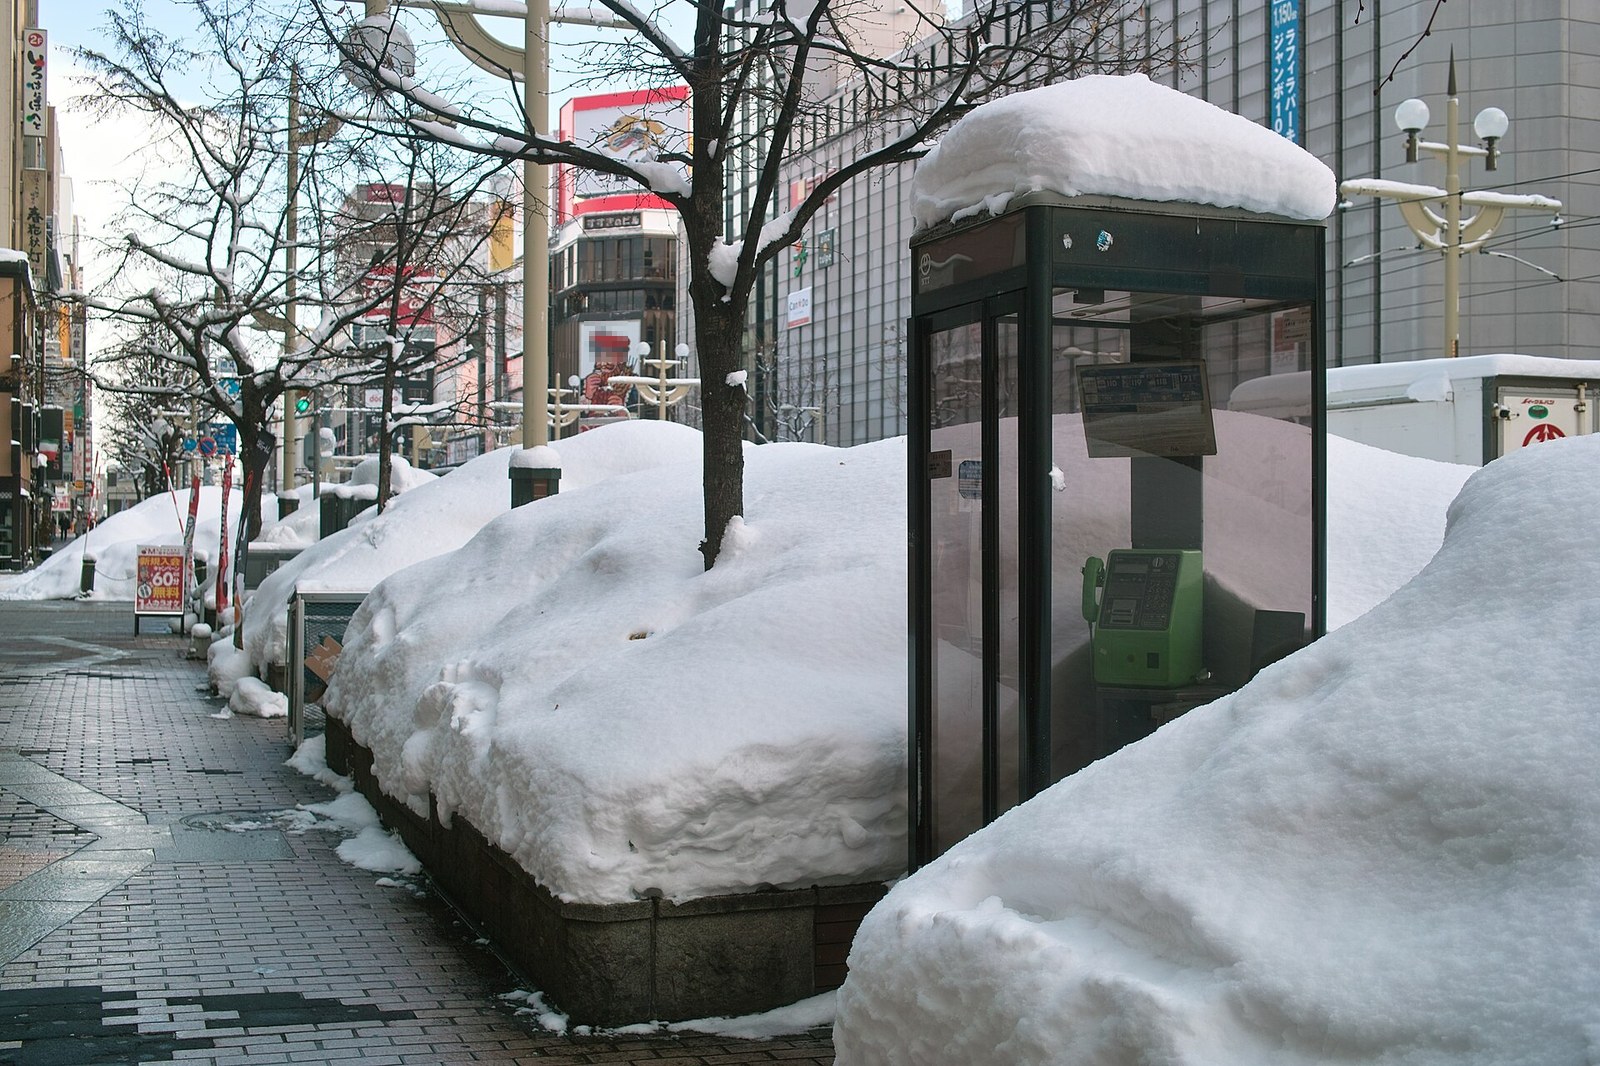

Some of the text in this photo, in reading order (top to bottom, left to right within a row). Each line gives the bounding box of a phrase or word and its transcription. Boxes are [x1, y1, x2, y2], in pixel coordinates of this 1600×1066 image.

[1106, 379, 1118, 387] 110
[1131, 378, 1142, 387] 119
[369, 394, 399, 403] doco
[139, 556, 180, 567] 新規入会
[153, 586, 179, 598] 無料
